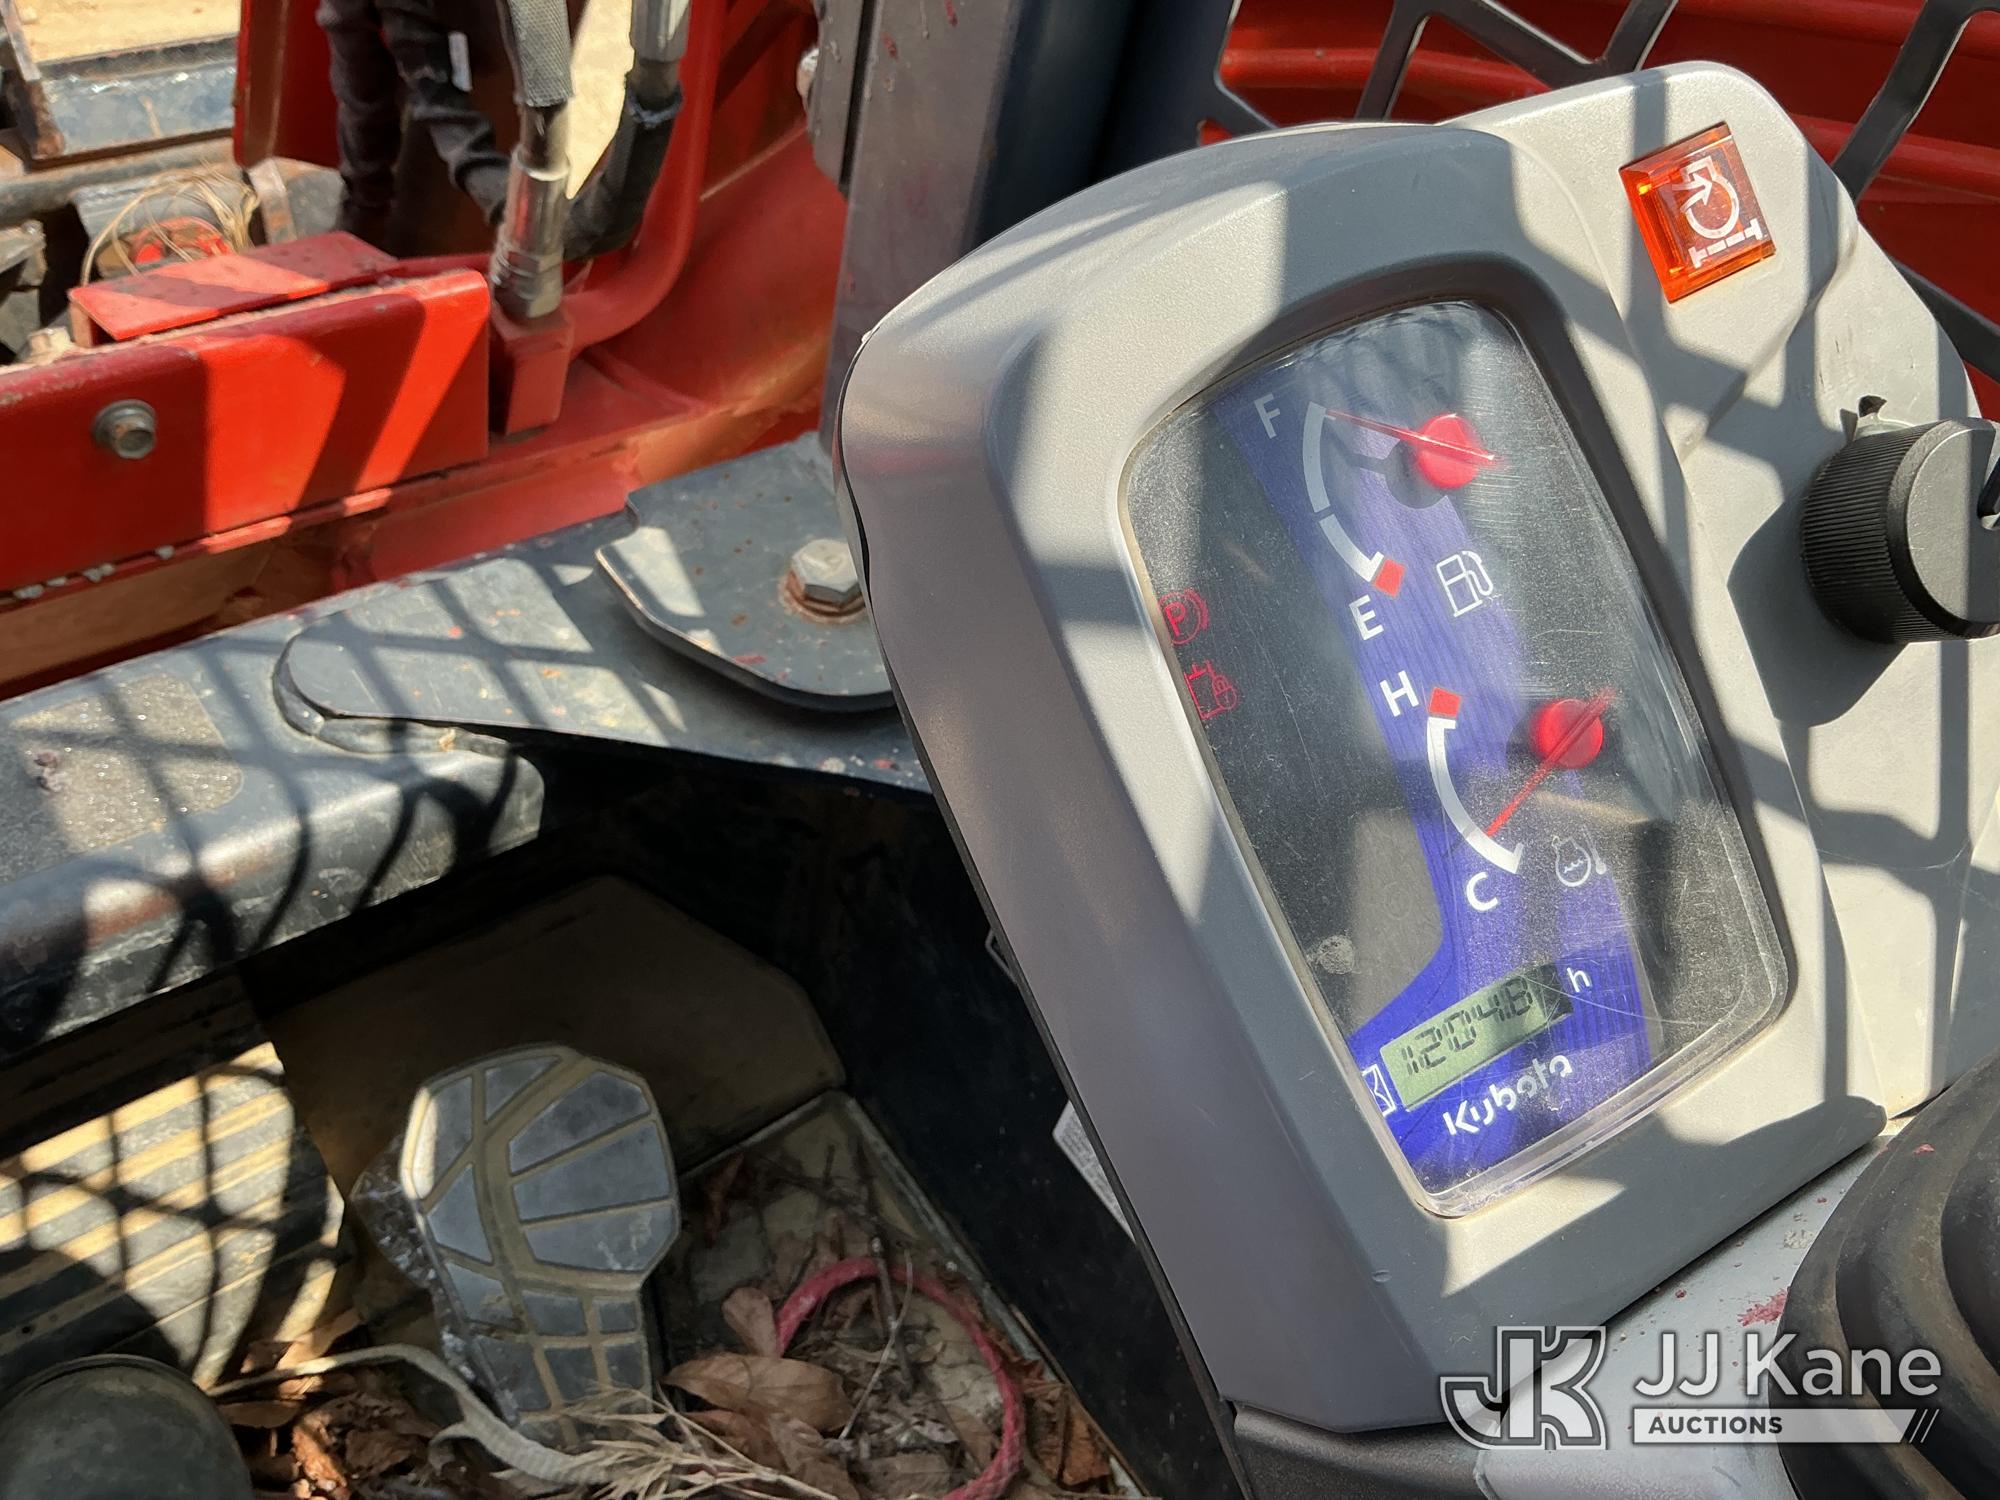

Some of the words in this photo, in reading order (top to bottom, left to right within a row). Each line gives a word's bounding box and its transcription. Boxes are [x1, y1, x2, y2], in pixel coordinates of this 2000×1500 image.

[1254, 393, 1281, 438] F
[1348, 595, 1385, 641] E
[1379, 670, 1420, 717] H
[1465, 872, 1499, 911] C
[1566, 966, 1592, 993] h
[1442, 1054, 1573, 1136] Kubota
